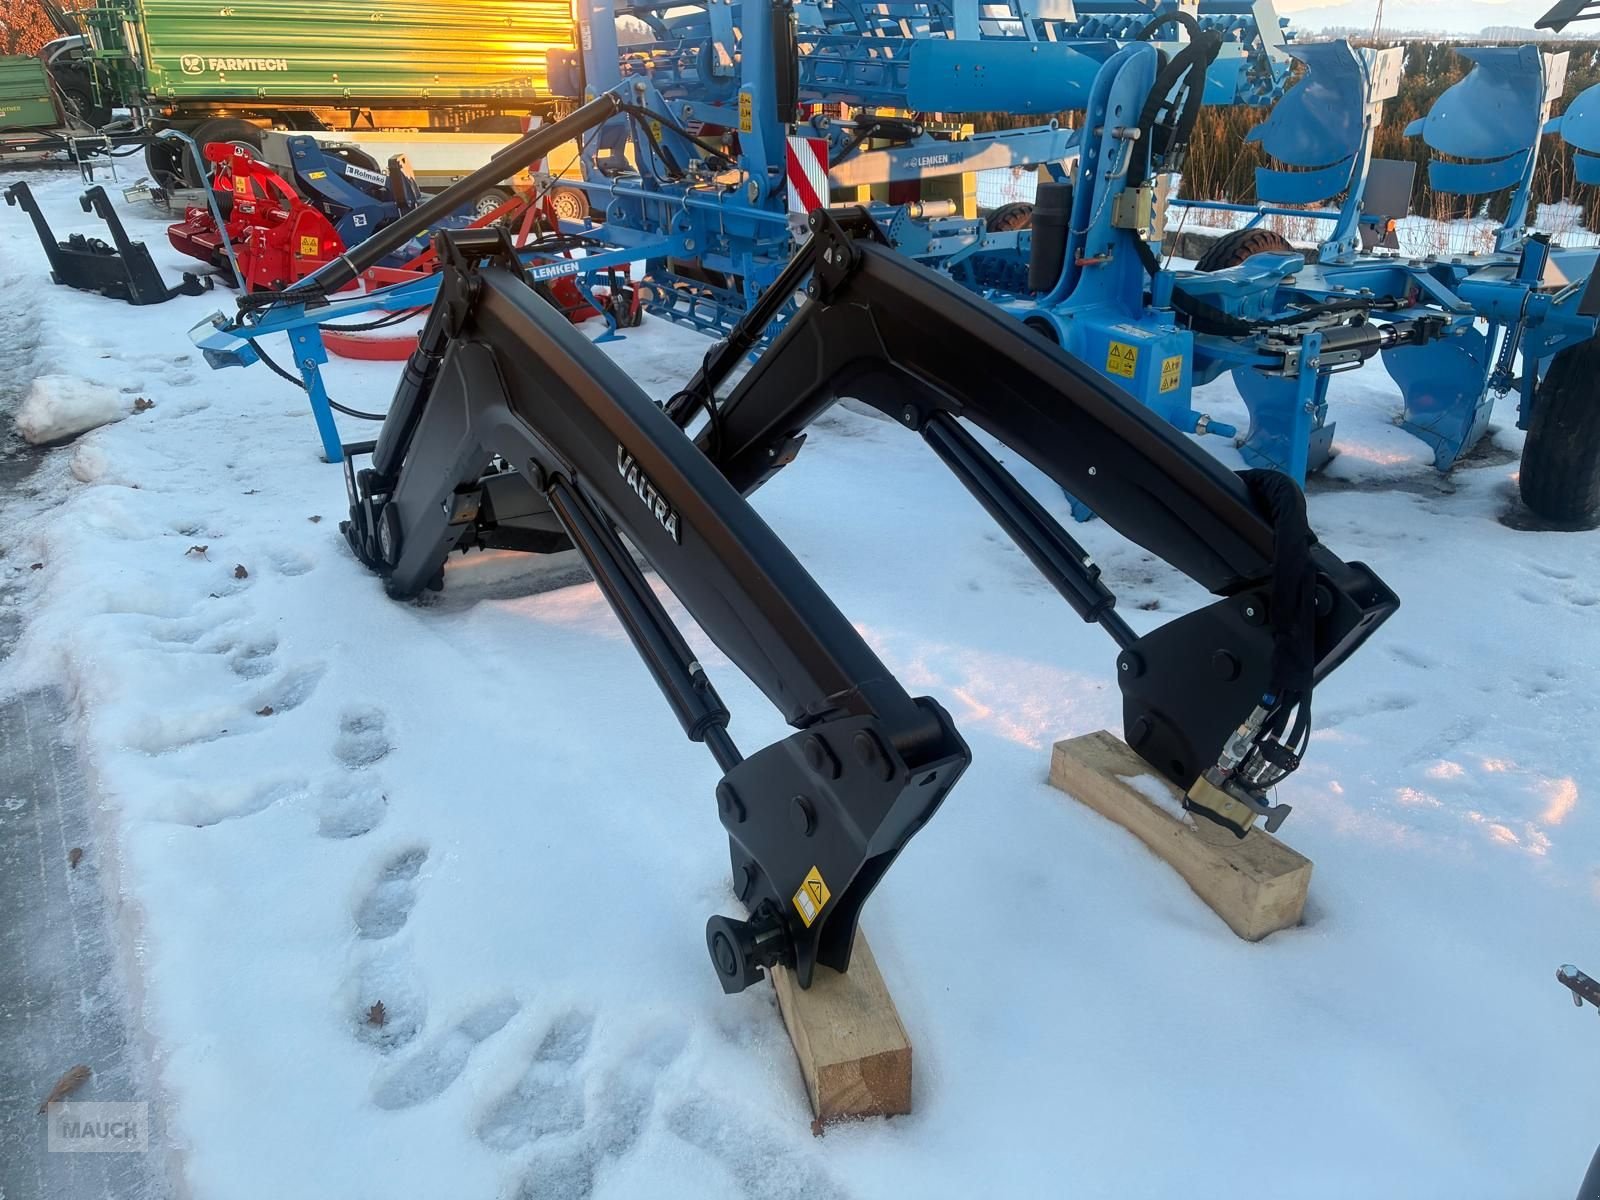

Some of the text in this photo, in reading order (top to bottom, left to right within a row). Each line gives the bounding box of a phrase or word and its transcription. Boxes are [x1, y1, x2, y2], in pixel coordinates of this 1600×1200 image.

[208, 58, 288, 71] FARMTECH
[918, 154, 949, 167] LEMKEN
[532, 261, 580, 279] LEMKEN
[617, 444, 679, 544] VALTRA
